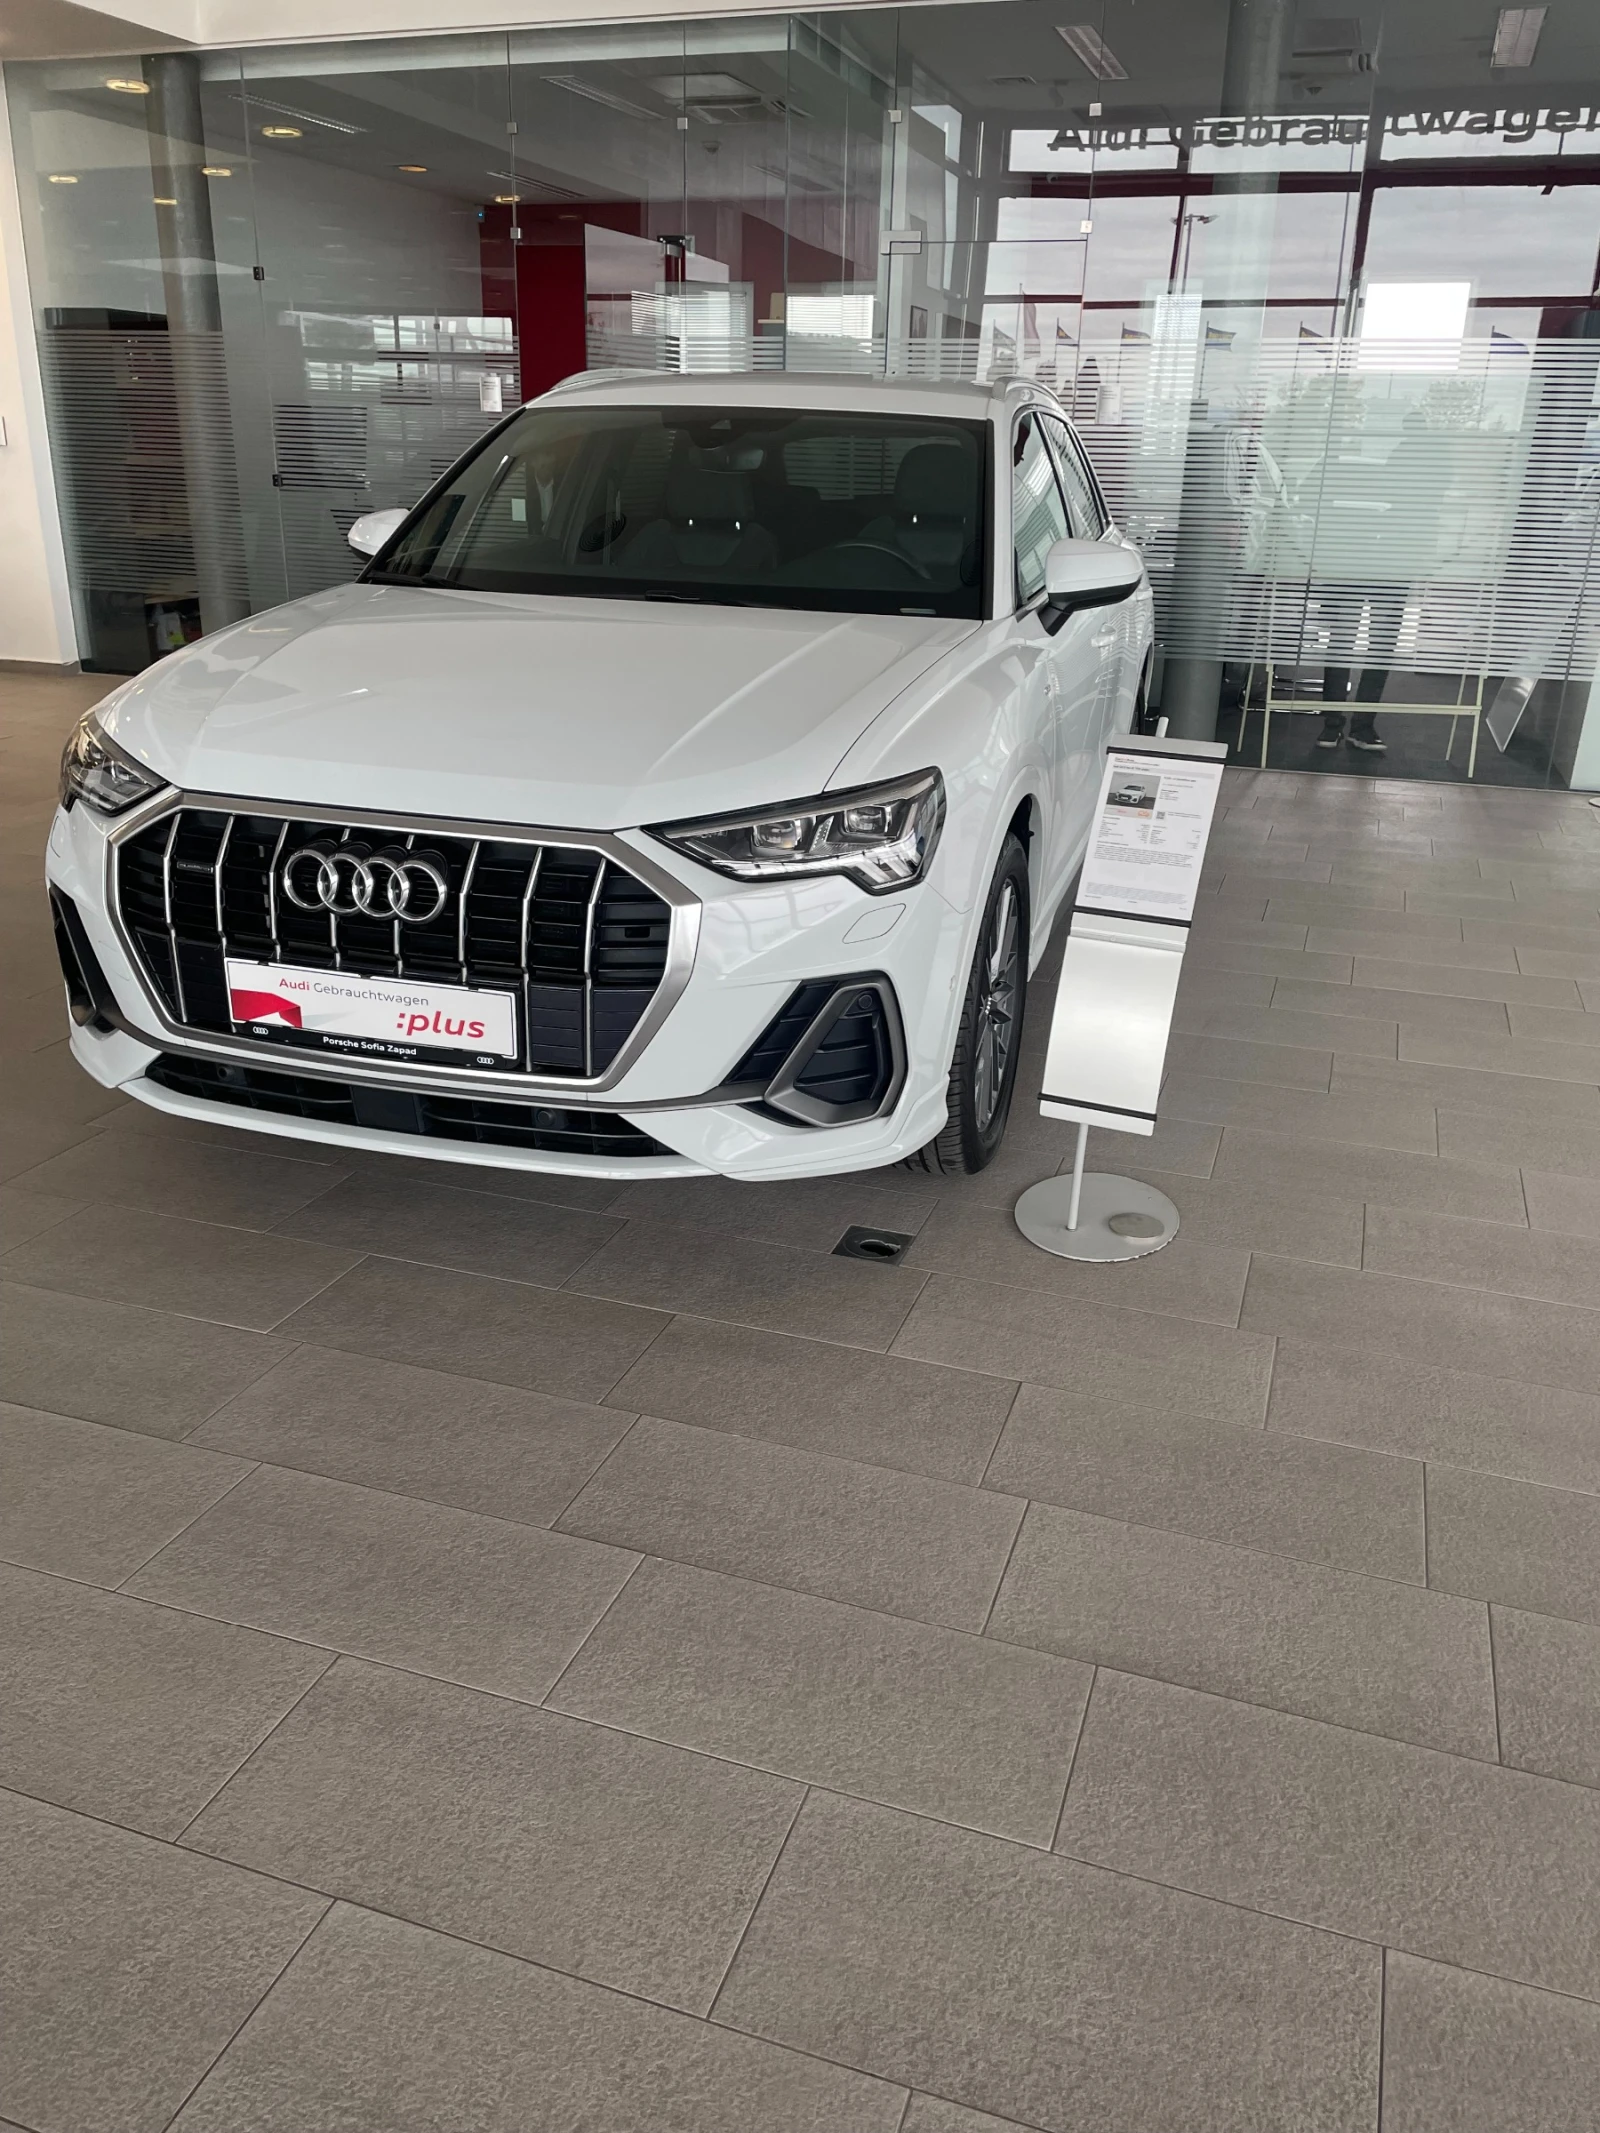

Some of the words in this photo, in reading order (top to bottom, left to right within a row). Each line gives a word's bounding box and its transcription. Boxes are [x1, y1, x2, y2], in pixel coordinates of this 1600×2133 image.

[279, 978, 310, 991] Audi
[313, 982, 429, 1006] Gebrauchtwagen
[396, 1010, 485, 1038] :plus
[322, 1036, 359, 1048] Porsche
[360, 1041, 385, 1051] Sofia
[387, 1044, 417, 1055] Zapad
